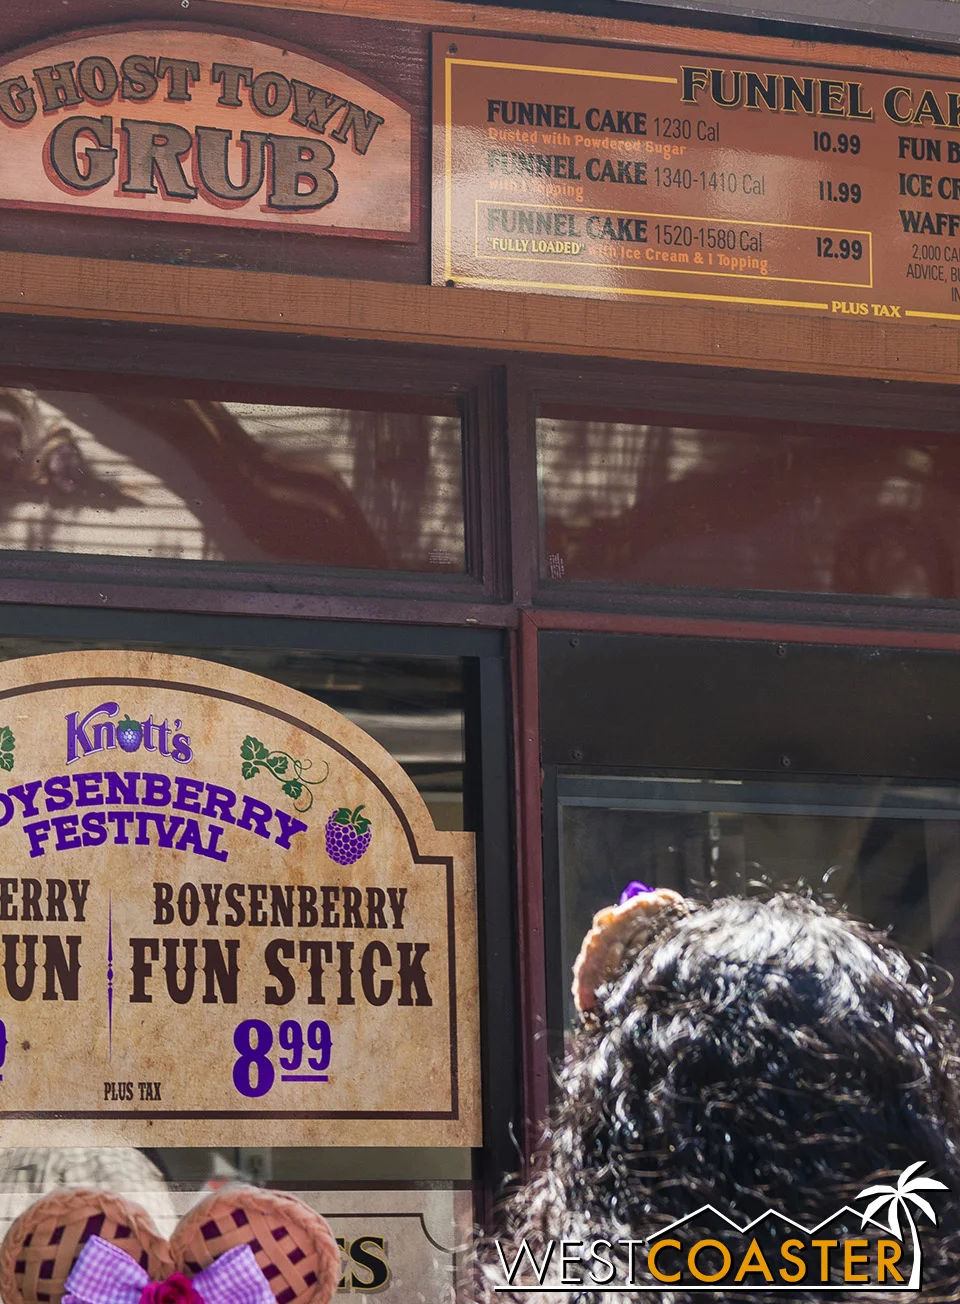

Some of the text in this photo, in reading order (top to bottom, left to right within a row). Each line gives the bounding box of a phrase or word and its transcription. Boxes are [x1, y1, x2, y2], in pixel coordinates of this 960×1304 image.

[211, 62, 385, 156] TOWN
[680, 66, 873, 120] FUNNEL
[487, 99, 720, 142] FUNNEL CAKE 1230 Cal
[487, 127, 687, 161] Dusted with Powdered Sugar
[813, 130, 861, 155] 10.99
[898, 136, 942, 163] FUN
[45, 115, 340, 211] GRUB
[487, 149, 766, 196] FUNNEL CAKE 1340-1410 Cal
[818, 180, 862, 204] 11.99
[898, 173, 933, 198] ICE
[487, 208, 763, 252] FUNNEL CAKE 1520-1580 Cal
[531, 240, 585, 256] LOADED"
[621, 246, 642, 260] Ice
[646, 248, 689, 264] Cream
[693, 253, 704, 265] &
[717, 254, 769, 275] Topping
[816, 237, 863, 261] 12.99
[912, 244, 941, 262] 2,000
[906, 263, 947, 284] ADVICE,
[831, 301, 901, 317] PLUS TAX
[64, 701, 194, 765] Knott's
[23, 810, 229, 863] FESTIVAL
[152, 882, 408, 929] BOYSENBERRY
[129, 938, 433, 1007] FUN STICK
[103, 1082, 161, 1101] PLUS TAX
